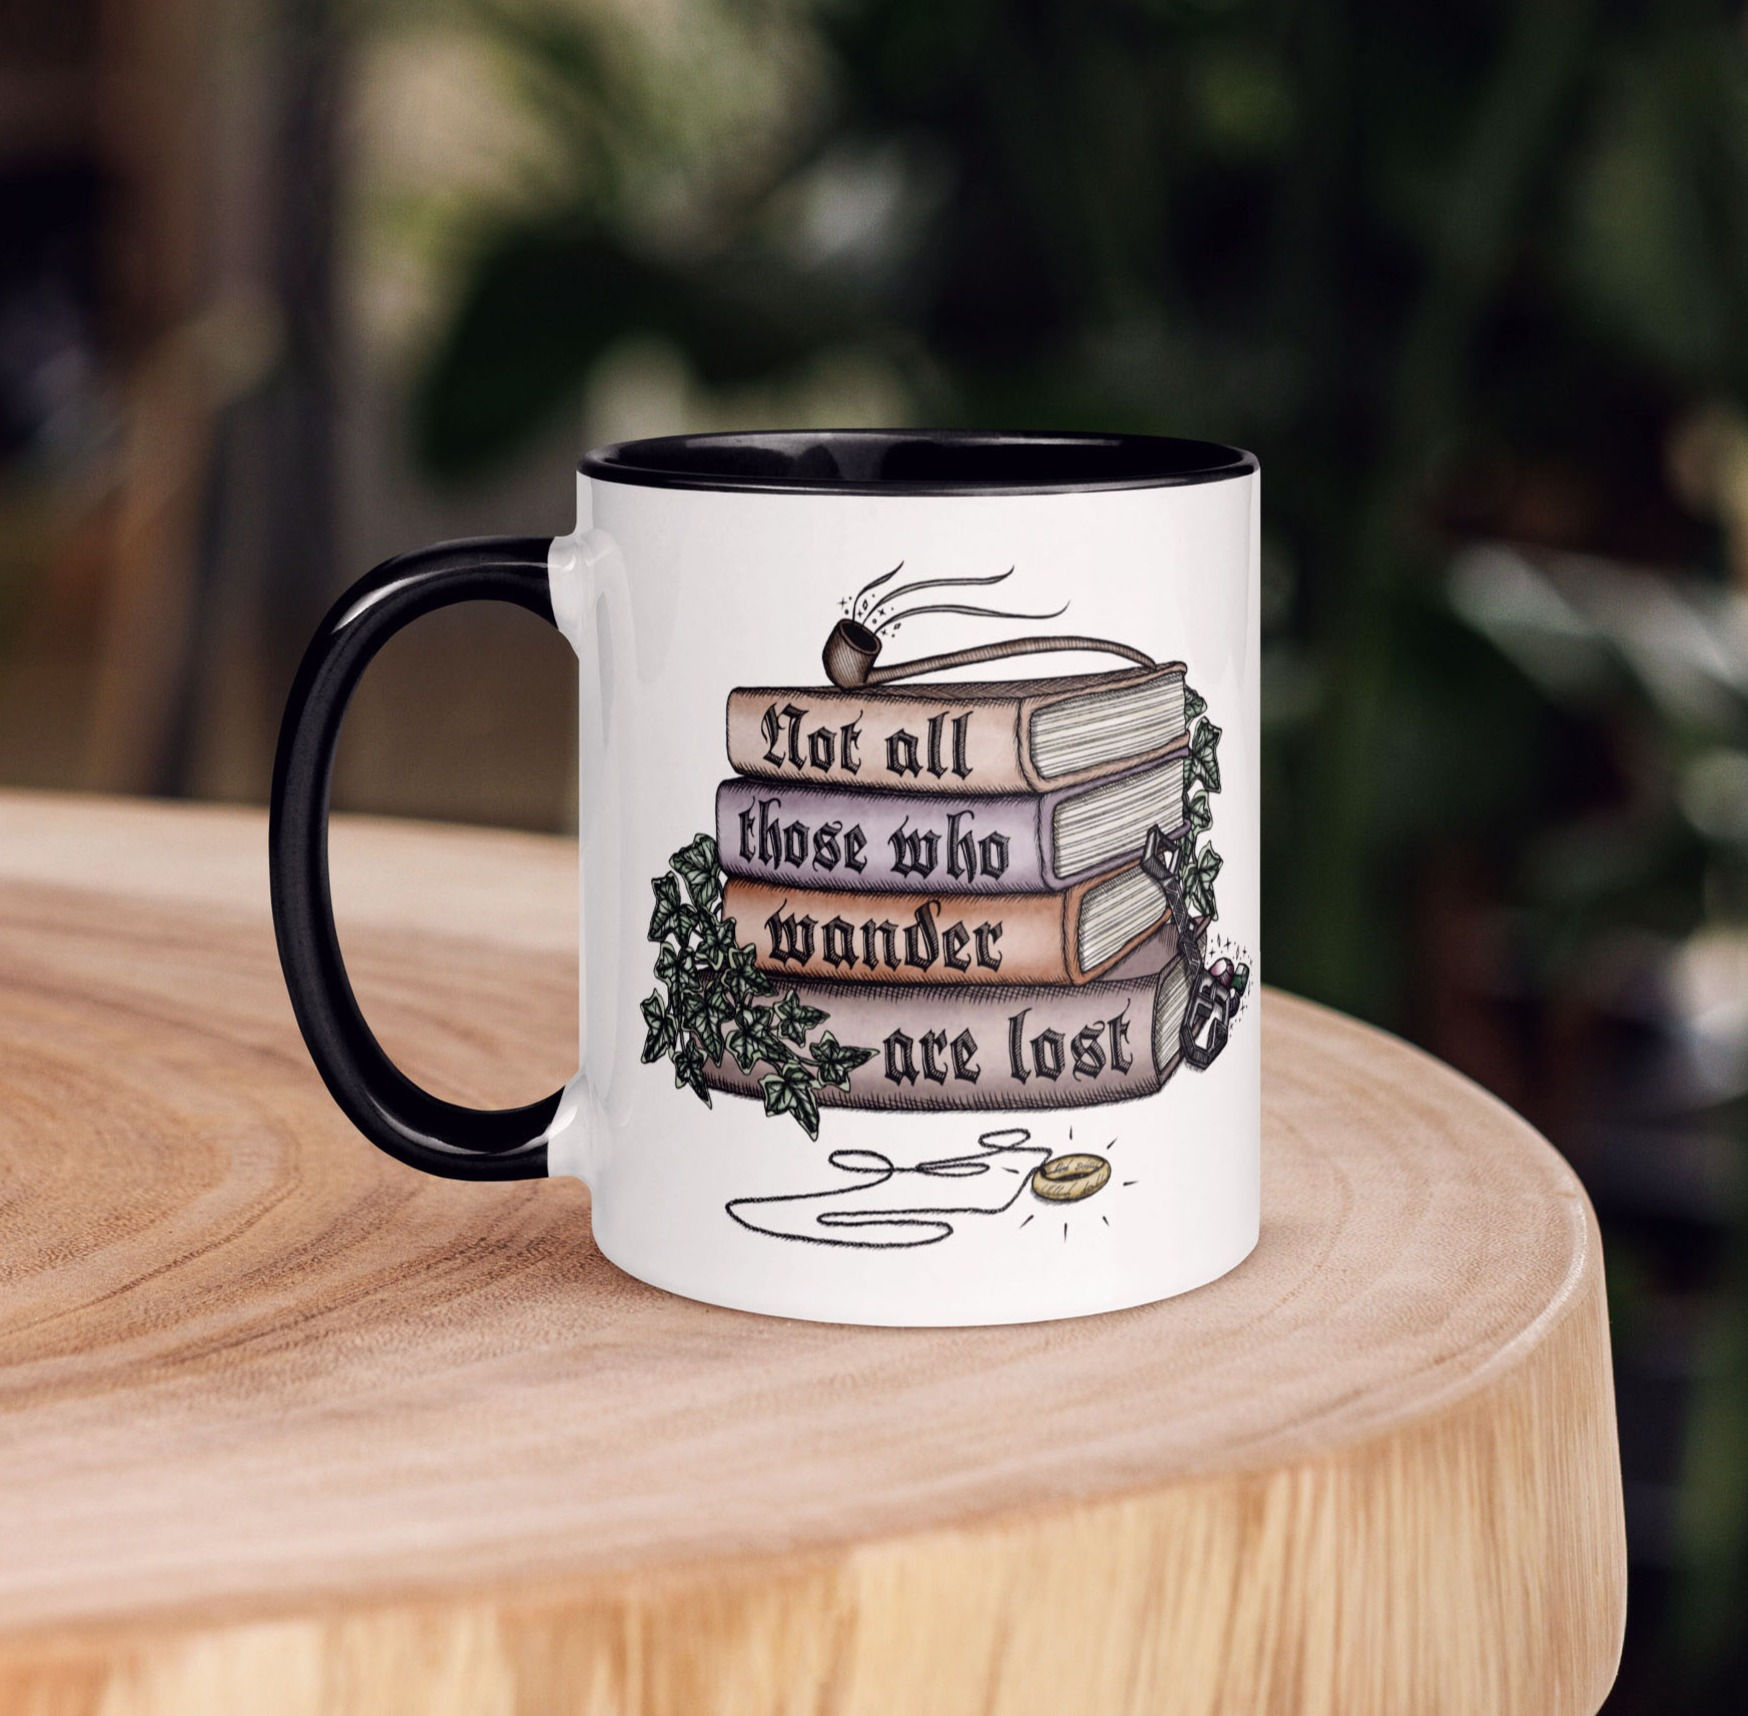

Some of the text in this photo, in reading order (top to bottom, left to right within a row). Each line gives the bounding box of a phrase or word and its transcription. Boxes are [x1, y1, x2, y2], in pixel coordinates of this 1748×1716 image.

[761, 703, 973, 780] Not all
[739, 796, 1010, 882] those who
[764, 899, 1003, 972] wander
[883, 998, 1133, 1085] are lost
